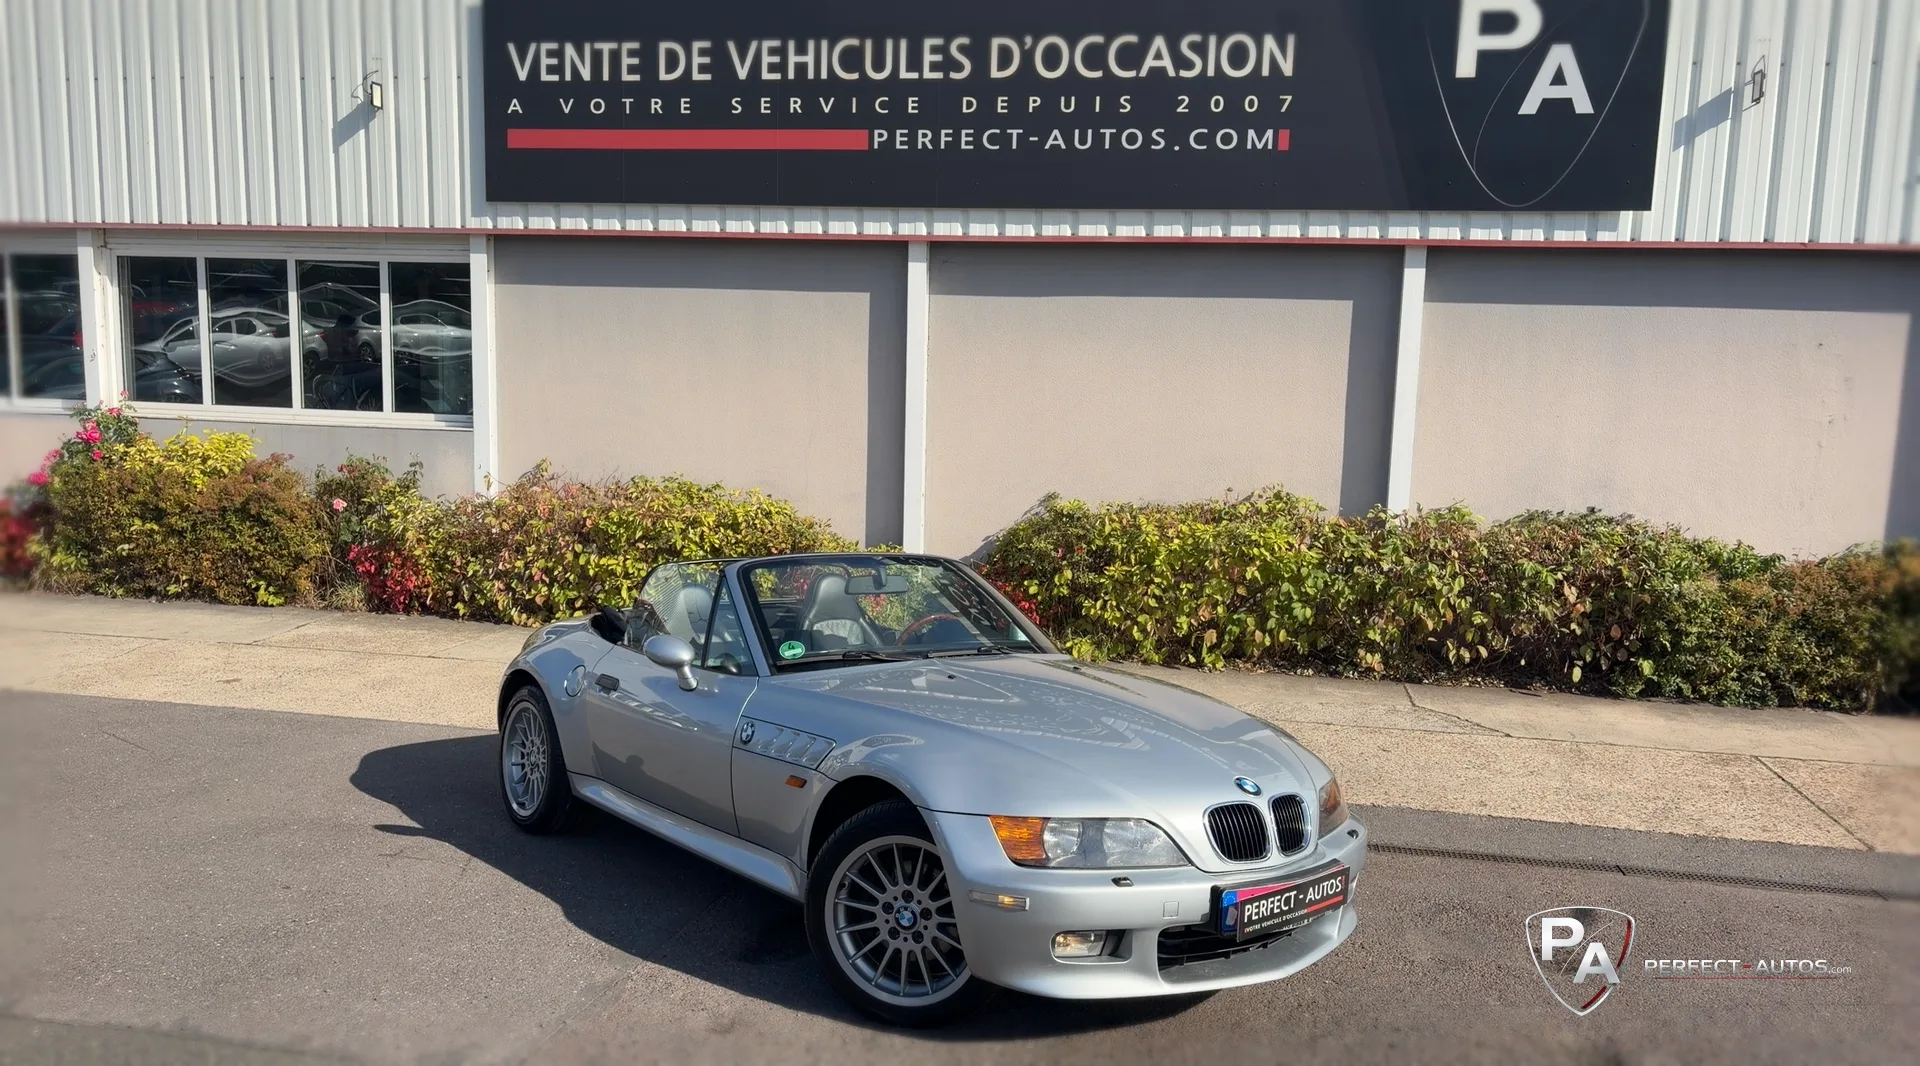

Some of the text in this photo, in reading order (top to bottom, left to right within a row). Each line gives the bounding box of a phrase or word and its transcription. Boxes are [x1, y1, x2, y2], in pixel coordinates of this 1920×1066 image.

[507, 33, 1296, 82] VENTE DE VEHICULES D'OCCASION
[507, 95, 1293, 115] A VOTRE SERVICE DEPUIS 2007
[873, 128, 1274, 151] PERFECT-AUTOS.COM
[1244, 890, 1297, 923] PERFECT
[1305, 876, 1342, 903] AUTOS
[1261, 916, 1282, 928] VEHICULE
[1282, 908, 1308, 921] D'OCCASION
